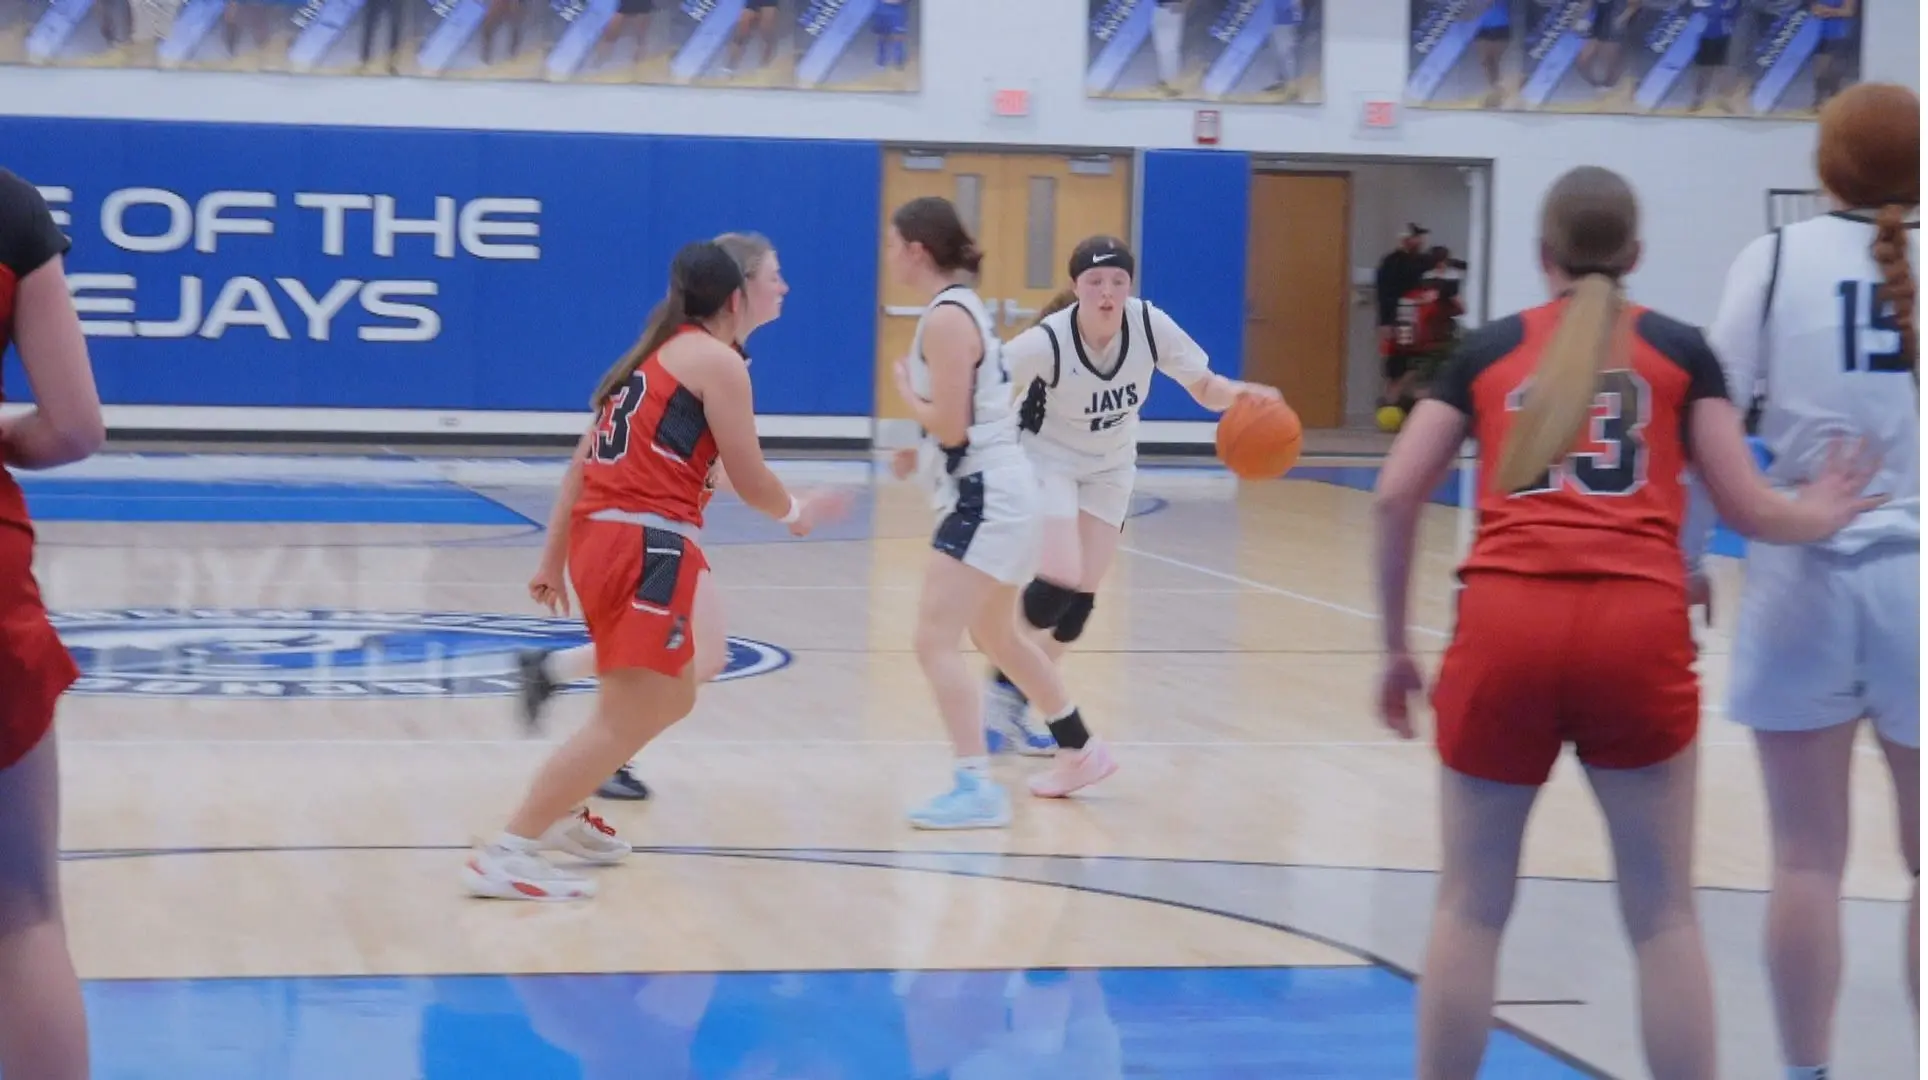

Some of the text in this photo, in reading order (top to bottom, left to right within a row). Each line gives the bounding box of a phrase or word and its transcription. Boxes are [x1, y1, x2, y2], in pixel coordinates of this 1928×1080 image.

[100, 187, 277, 254] OF
[294, 191, 543, 260] THE
[1084, 382, 1138, 415] JAYS
